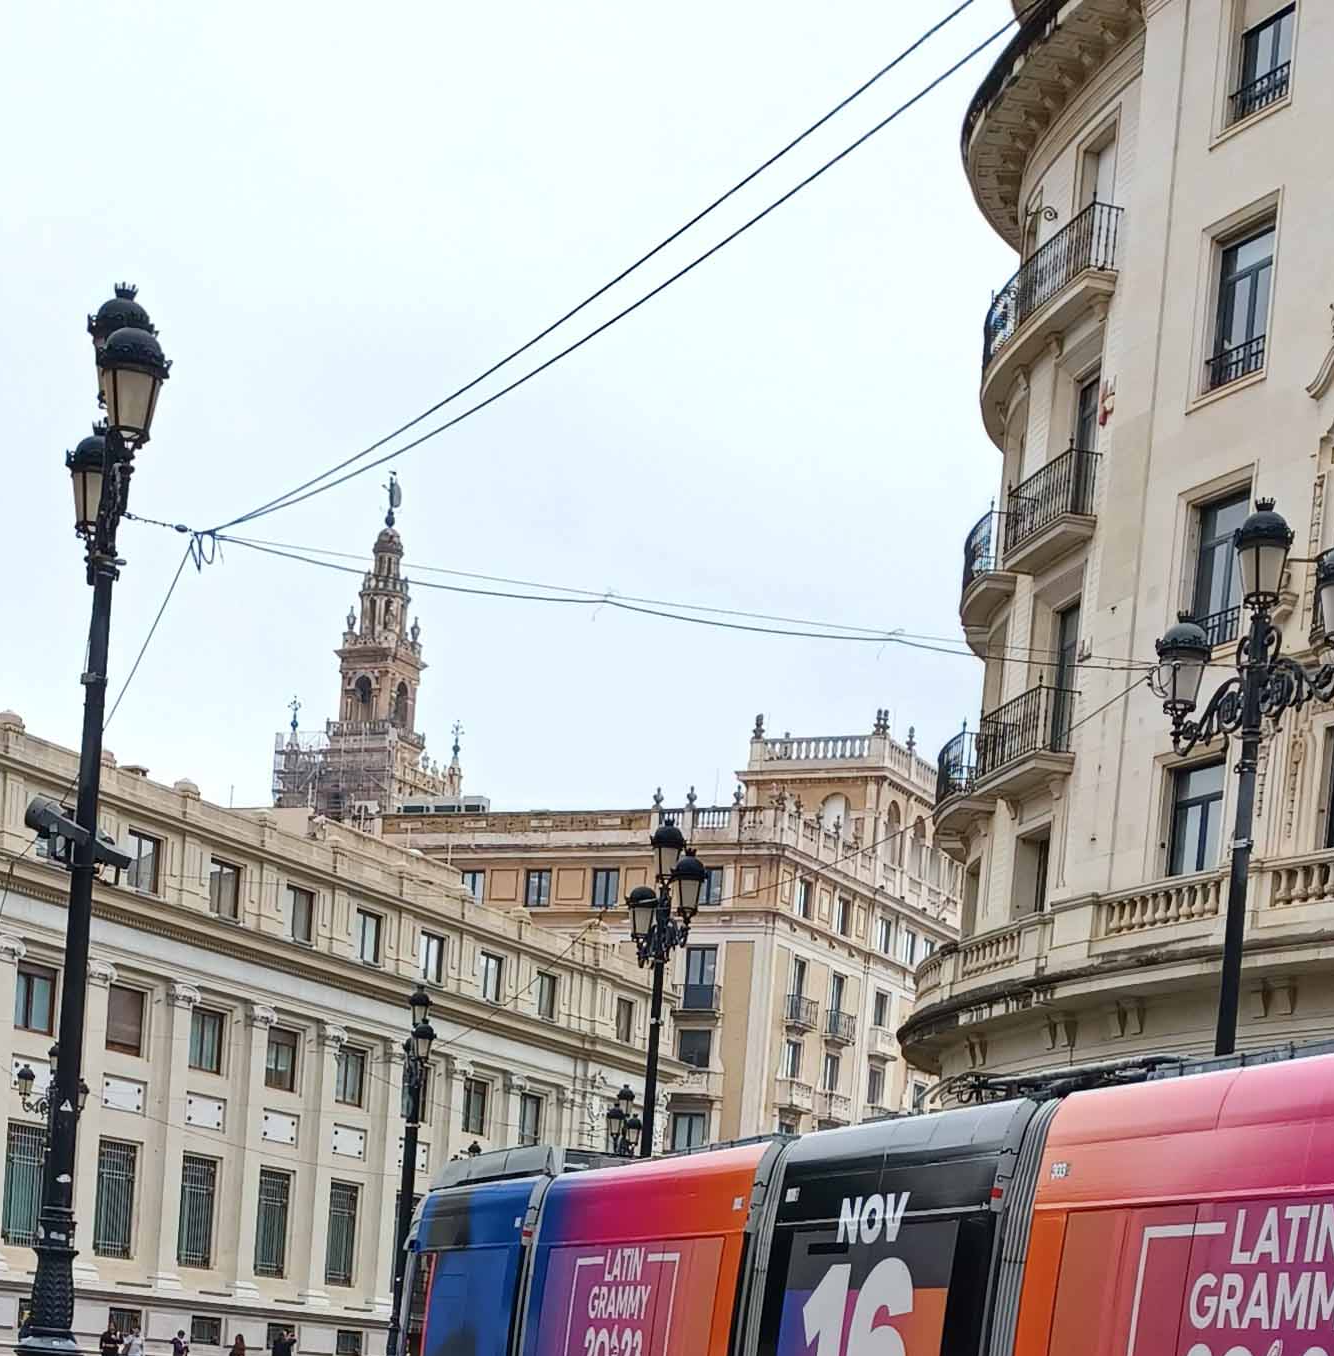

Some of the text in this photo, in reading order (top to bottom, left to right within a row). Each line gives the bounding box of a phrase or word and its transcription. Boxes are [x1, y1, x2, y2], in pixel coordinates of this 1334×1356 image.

[835, 1190, 912, 1245] NOV
[603, 1246, 646, 1282] LATIN
[587, 1285, 652, 1320] GRAMMY
